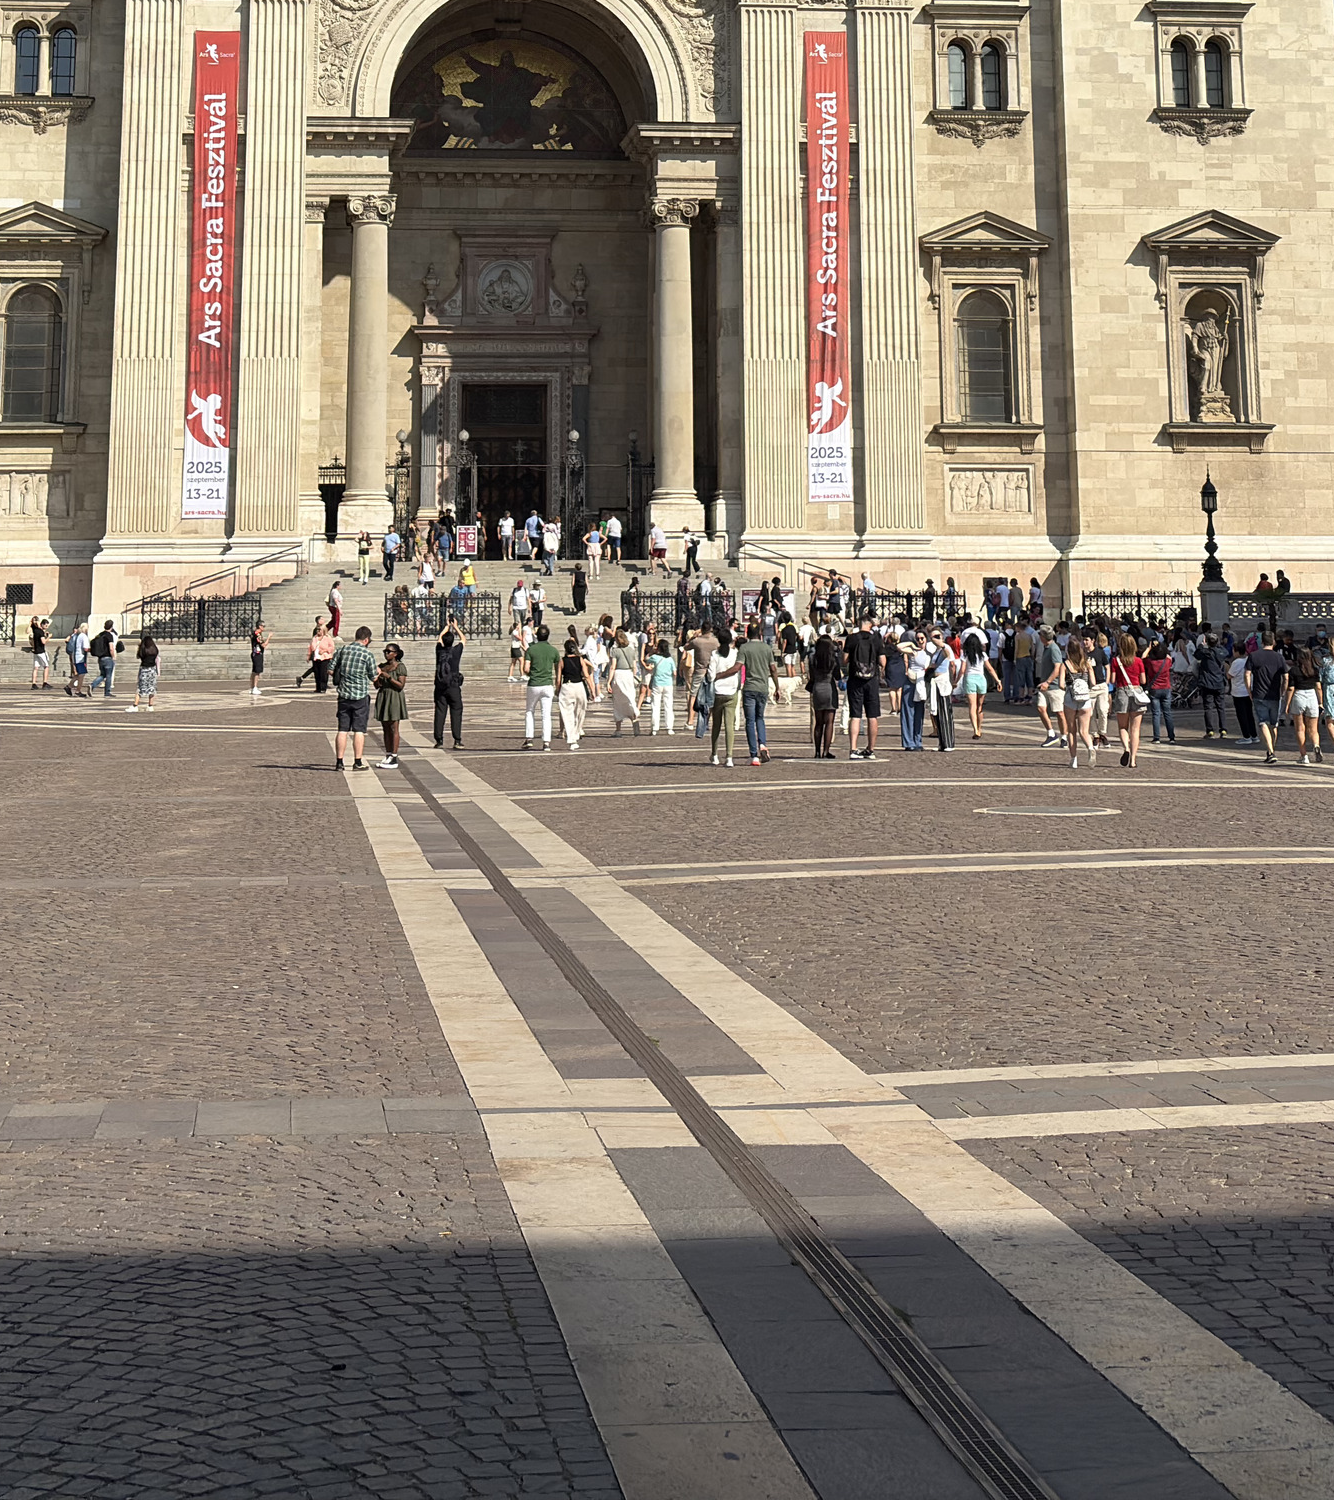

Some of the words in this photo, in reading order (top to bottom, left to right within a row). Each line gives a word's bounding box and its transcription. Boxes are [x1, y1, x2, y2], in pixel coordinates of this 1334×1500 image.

[201, 92, 226, 209] Fesztivál
[815, 91, 837, 203] Fesztivál
[199, 217, 224, 293] Sacra
[816, 211, 837, 284] Sacra
[198, 301, 222, 348] Ars
[816, 292, 837, 337] Ars
[186, 461, 226, 474] 2025.
[810, 446, 847, 459] 2025.
[186, 476, 226, 484] szeptember
[186, 488, 225, 500] 13-21.
[811, 472, 848, 483] 13-21.
